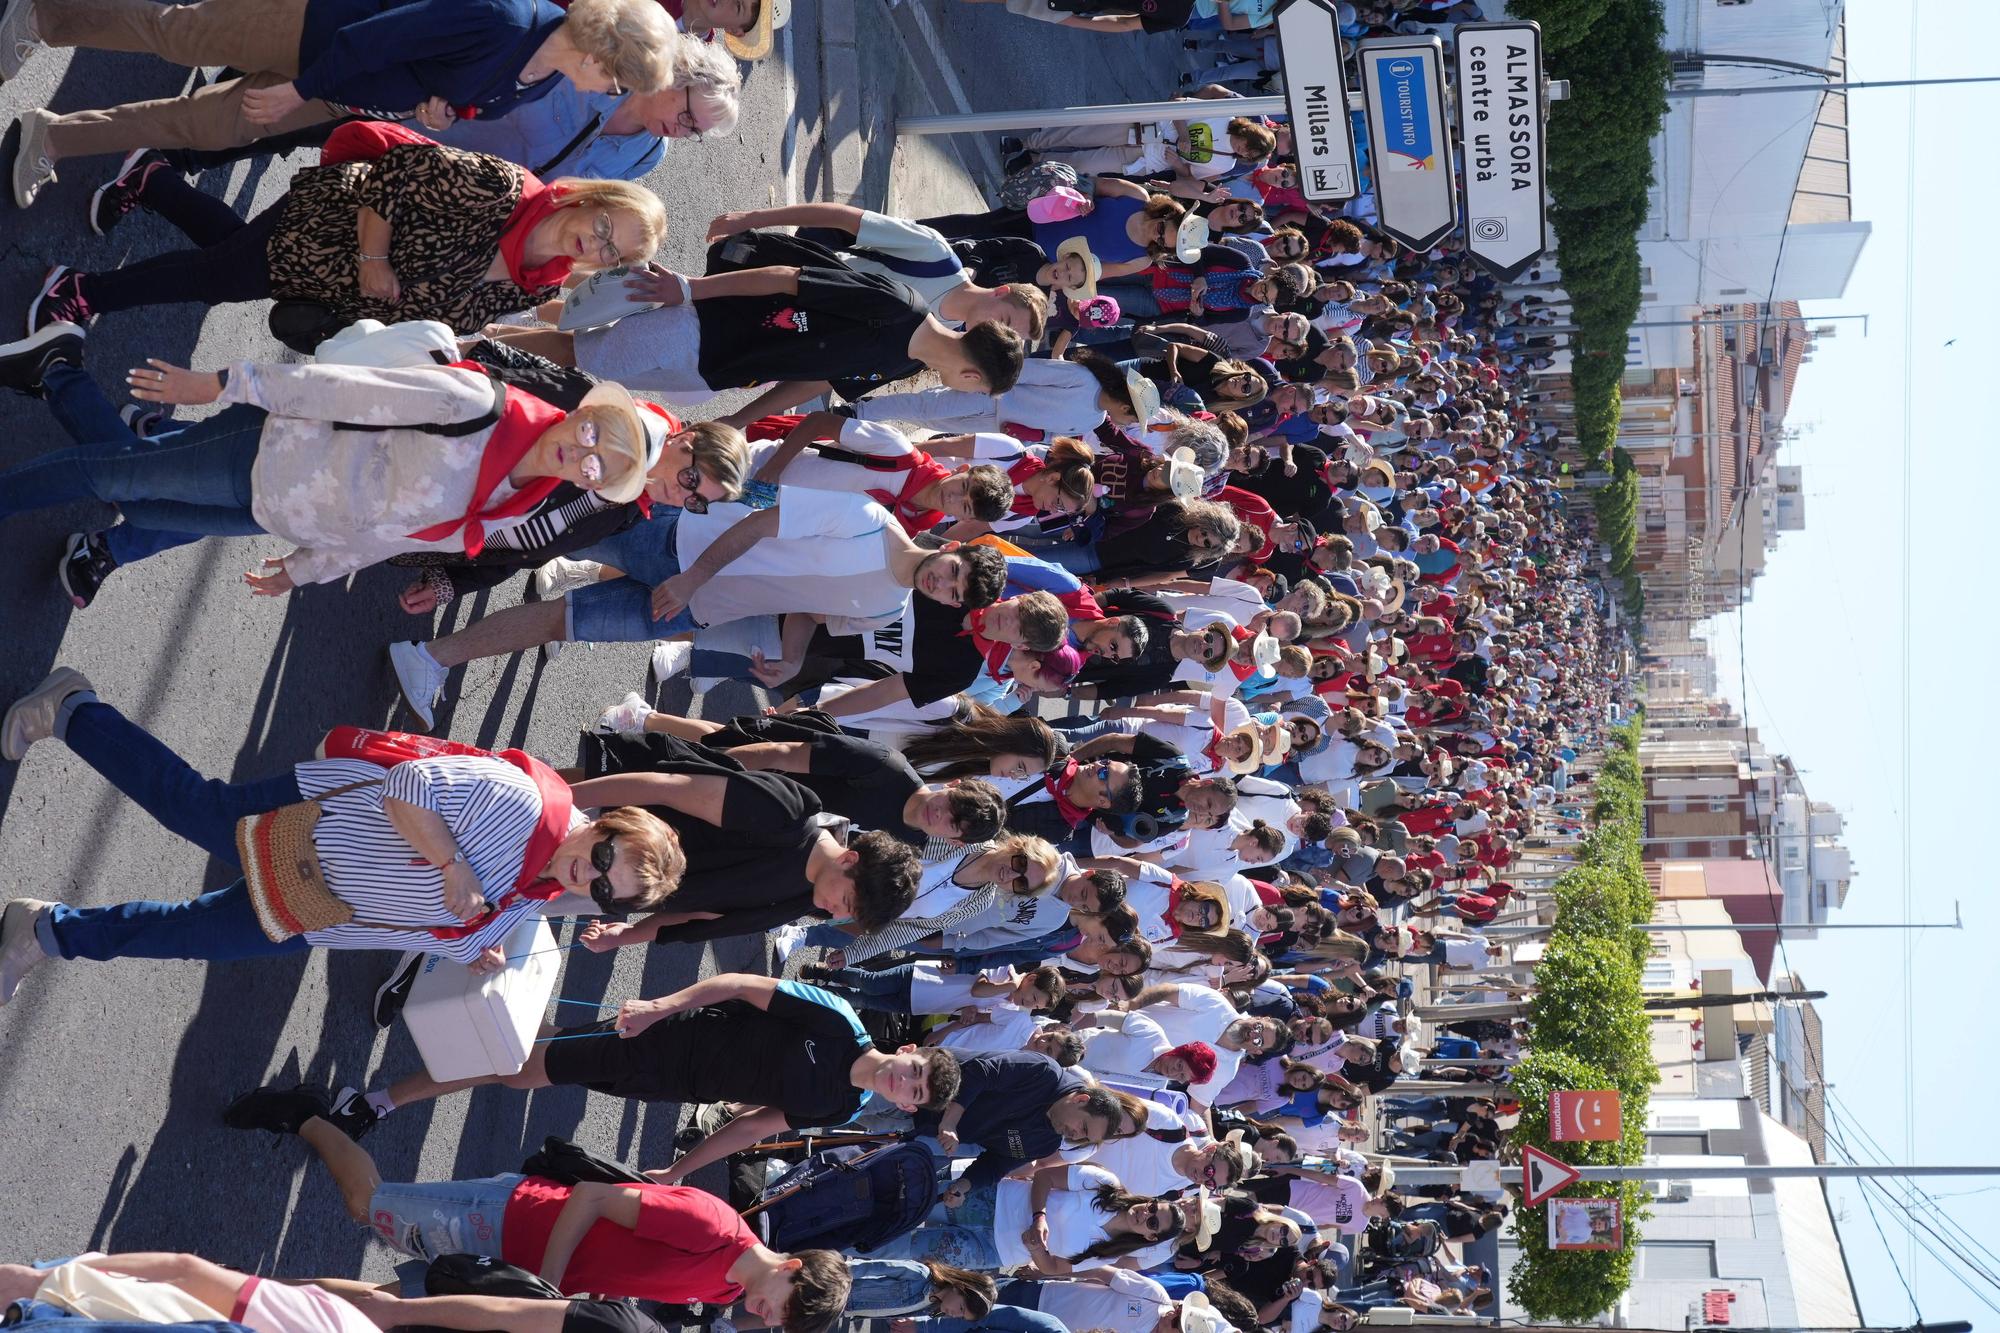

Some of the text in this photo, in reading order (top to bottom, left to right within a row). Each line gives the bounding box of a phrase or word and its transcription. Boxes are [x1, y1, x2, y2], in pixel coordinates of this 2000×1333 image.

[1303, 85, 1330, 157] Millars
[1397, 80, 1416, 146] TOURIST INFO
[1470, 46, 1497, 182] centre urbà
[1506, 44, 1531, 191] ALMASSORA
[799, 311, 809, 332] burn
